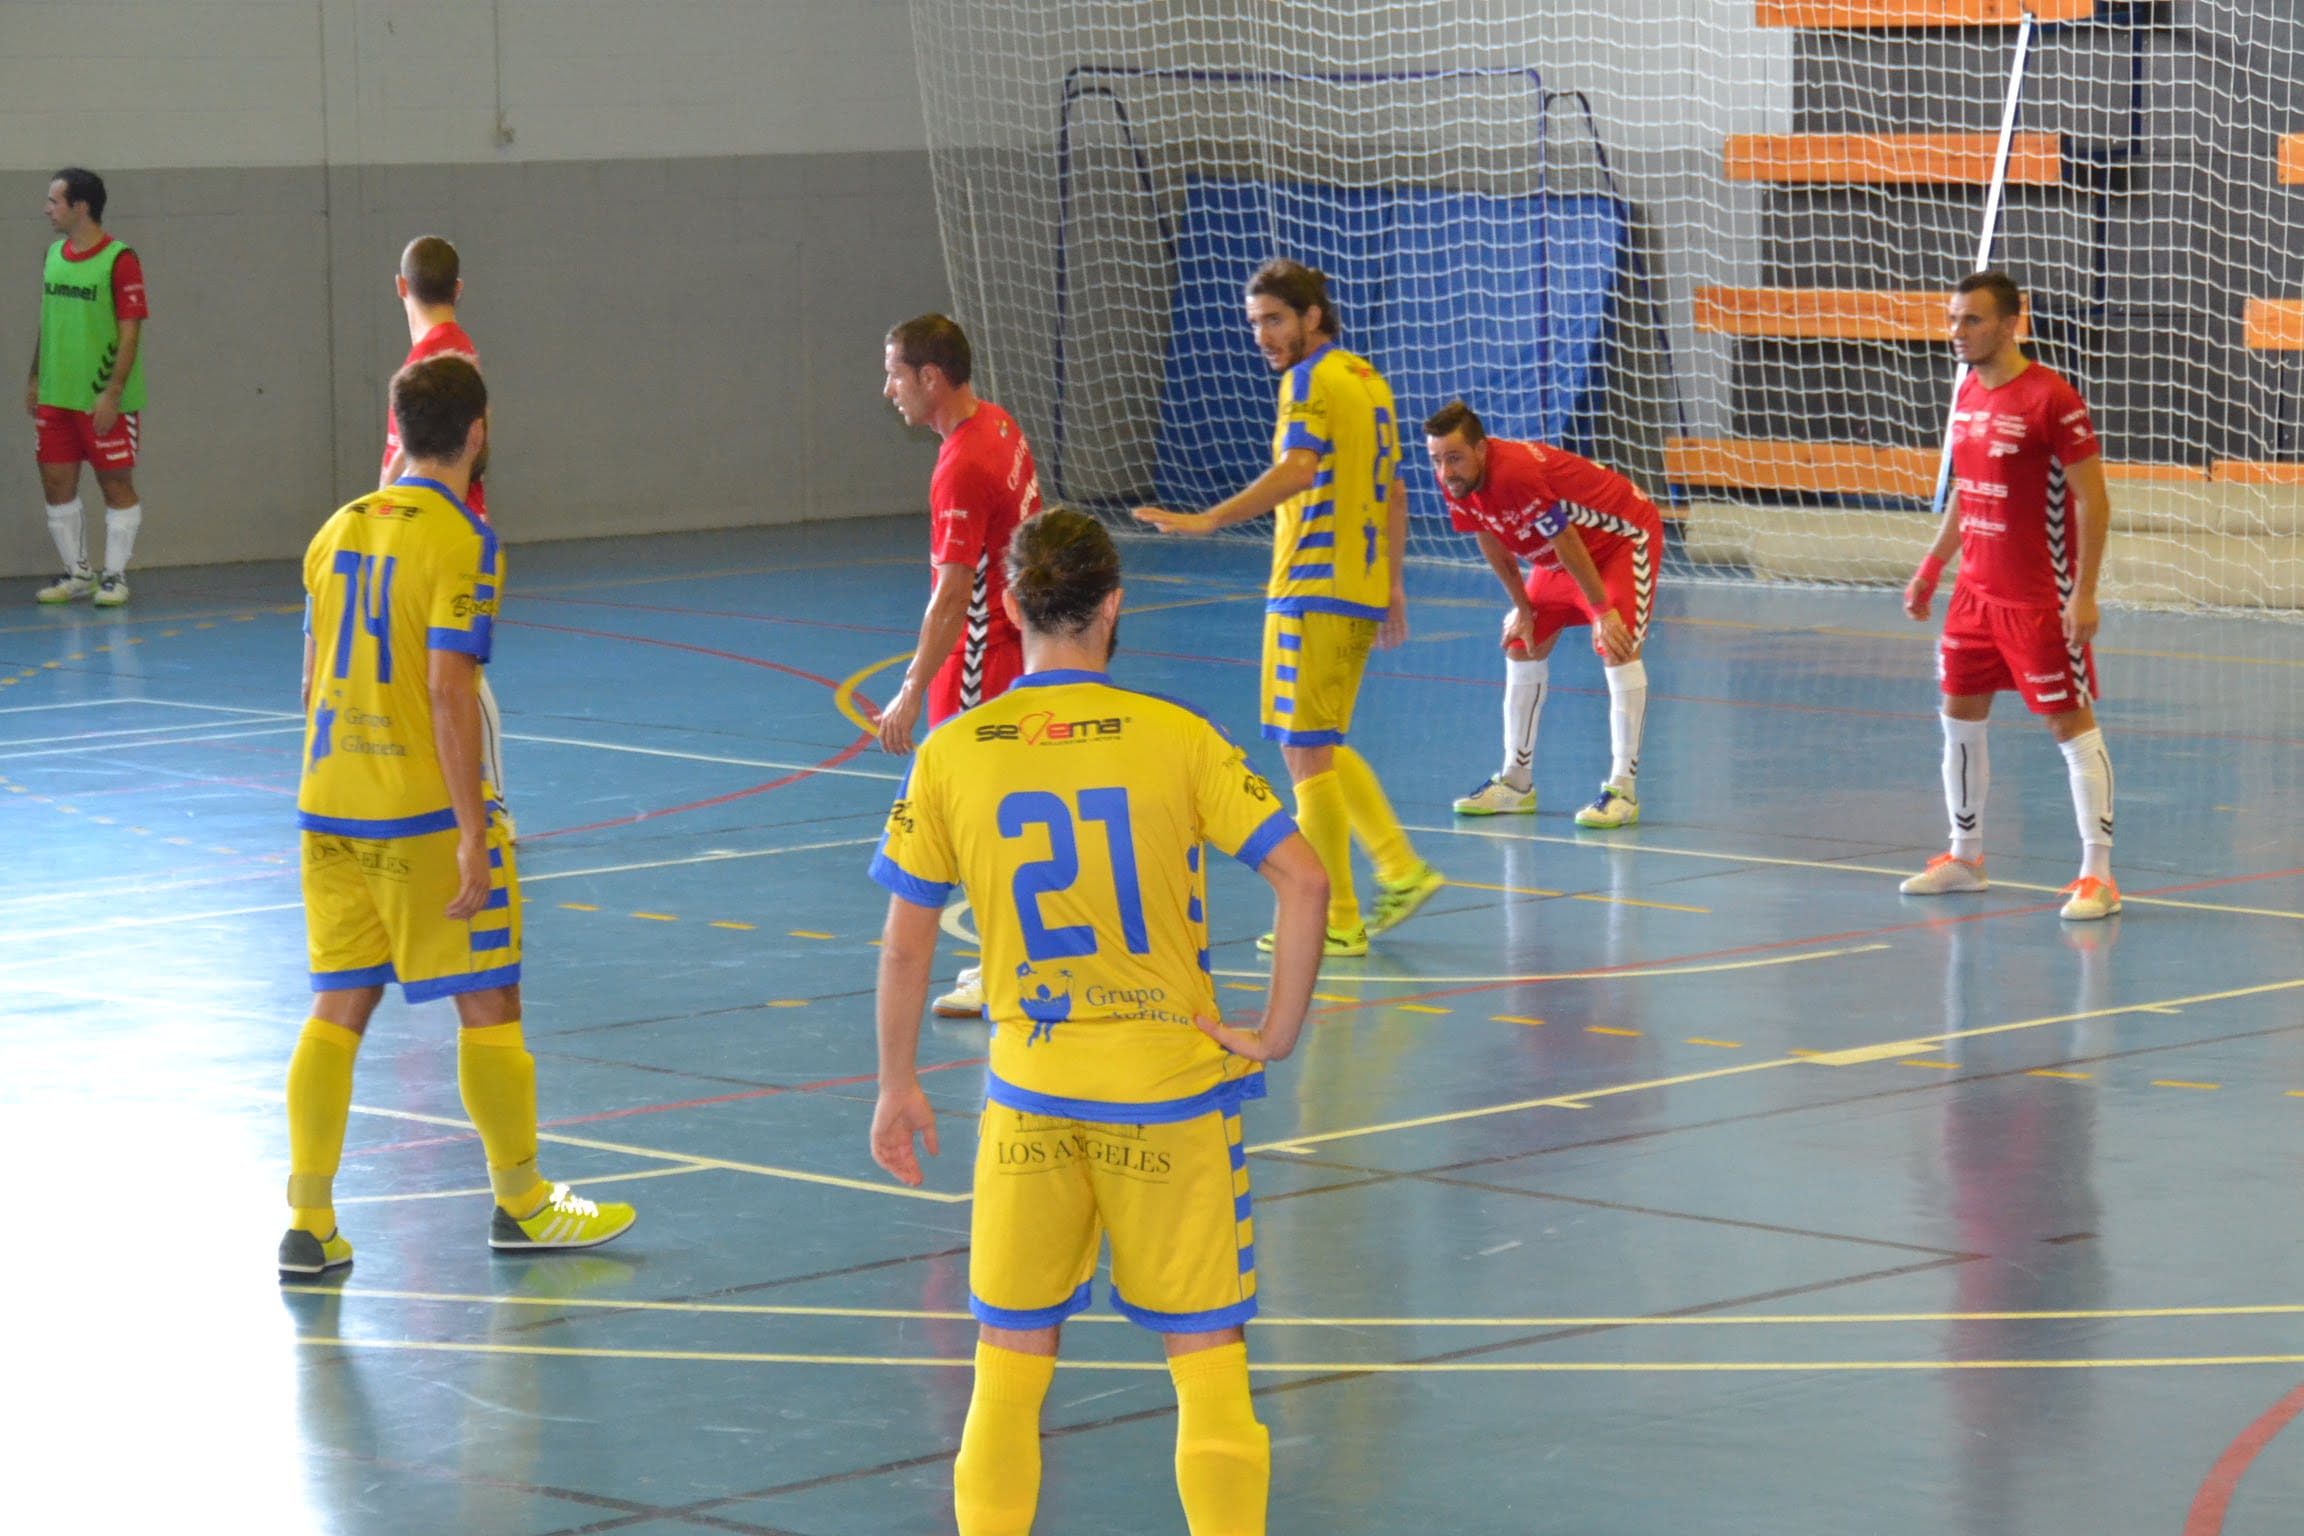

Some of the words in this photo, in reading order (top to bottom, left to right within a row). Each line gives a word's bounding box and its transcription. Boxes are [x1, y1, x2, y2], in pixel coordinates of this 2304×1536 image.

[1534, 515, 1560, 538] C
[1085, 985, 1166, 1009] Grupo
[998, 1141, 1046, 1166] LOS
[1053, 1134, 1172, 1175] ANGELES
